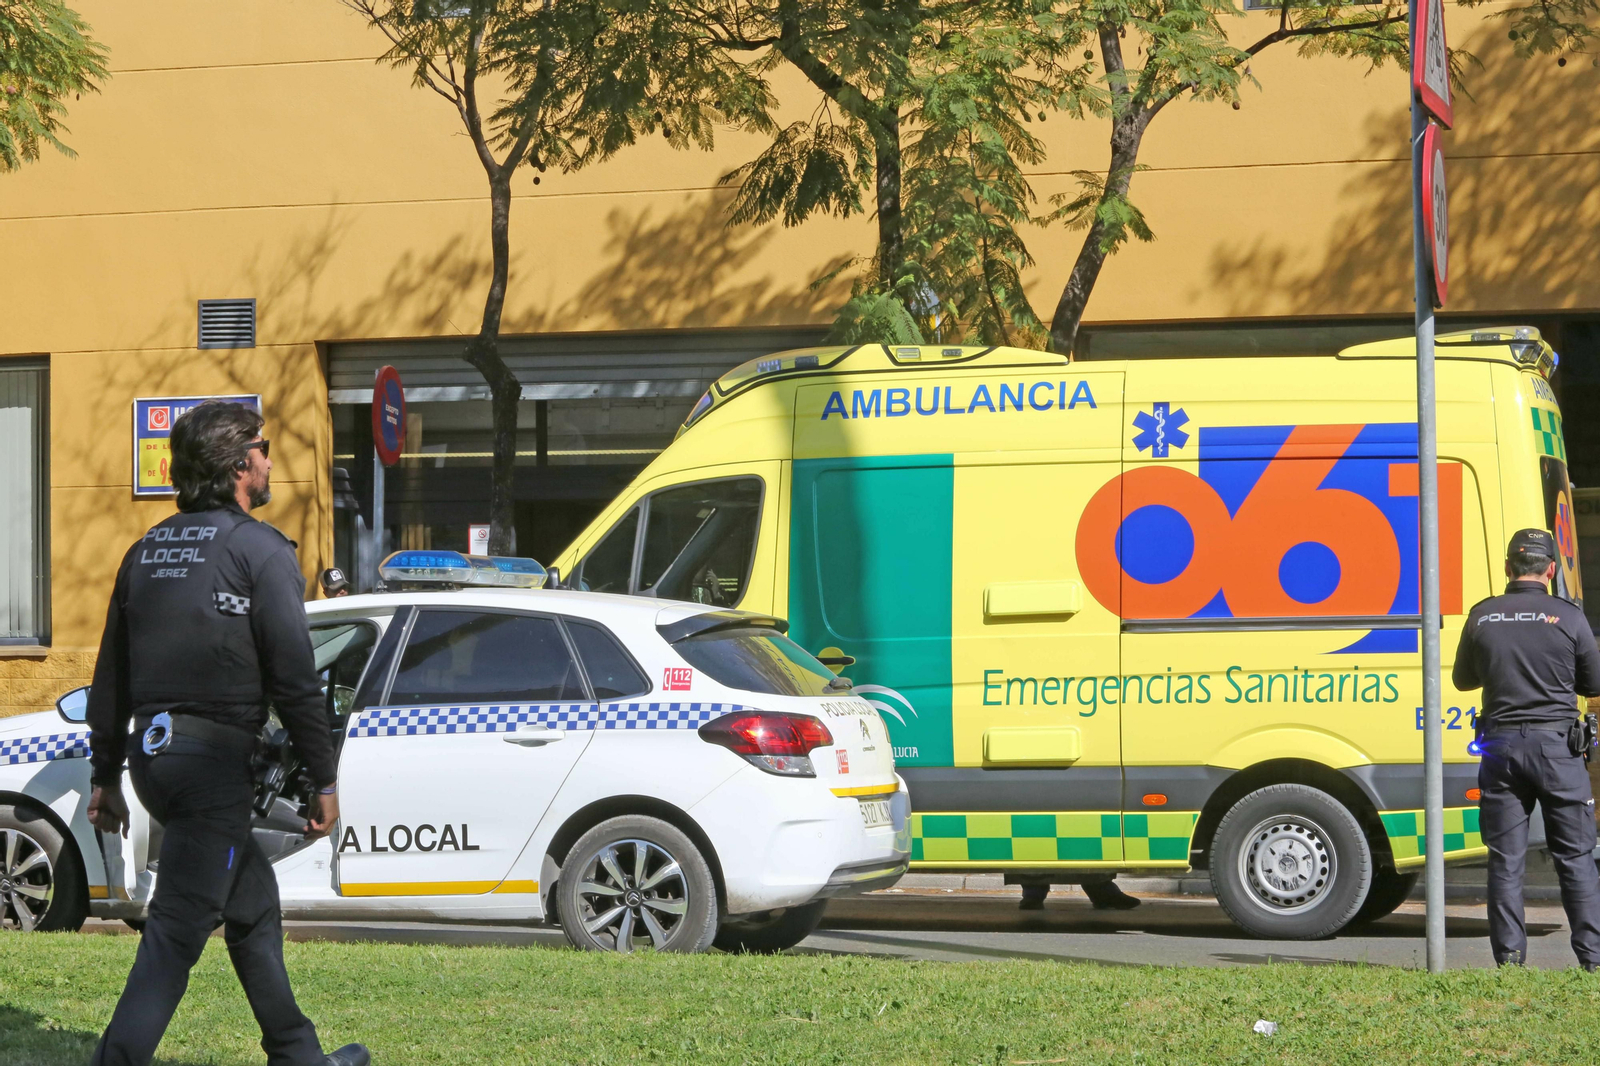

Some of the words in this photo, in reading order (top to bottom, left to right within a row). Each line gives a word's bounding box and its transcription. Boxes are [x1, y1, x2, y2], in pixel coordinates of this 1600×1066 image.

[1434, 183, 1446, 247] 30
[820, 380, 1098, 421] AMBULANCIA
[147, 469, 156, 477] DE
[1075, 424, 1463, 618] 061
[142, 526, 217, 542] POLICIA
[141, 548, 205, 564] LOCAL
[151, 568, 188, 578] JEREZ
[1477, 612, 1548, 626] POLICIA
[673, 669, 691, 681] 112
[982, 666, 1212, 718] Emergencias
[1224, 665, 1400, 704] Sanitarias
[892, 746, 919, 758] LUCIA
[370, 823, 480, 852] LOCAL
